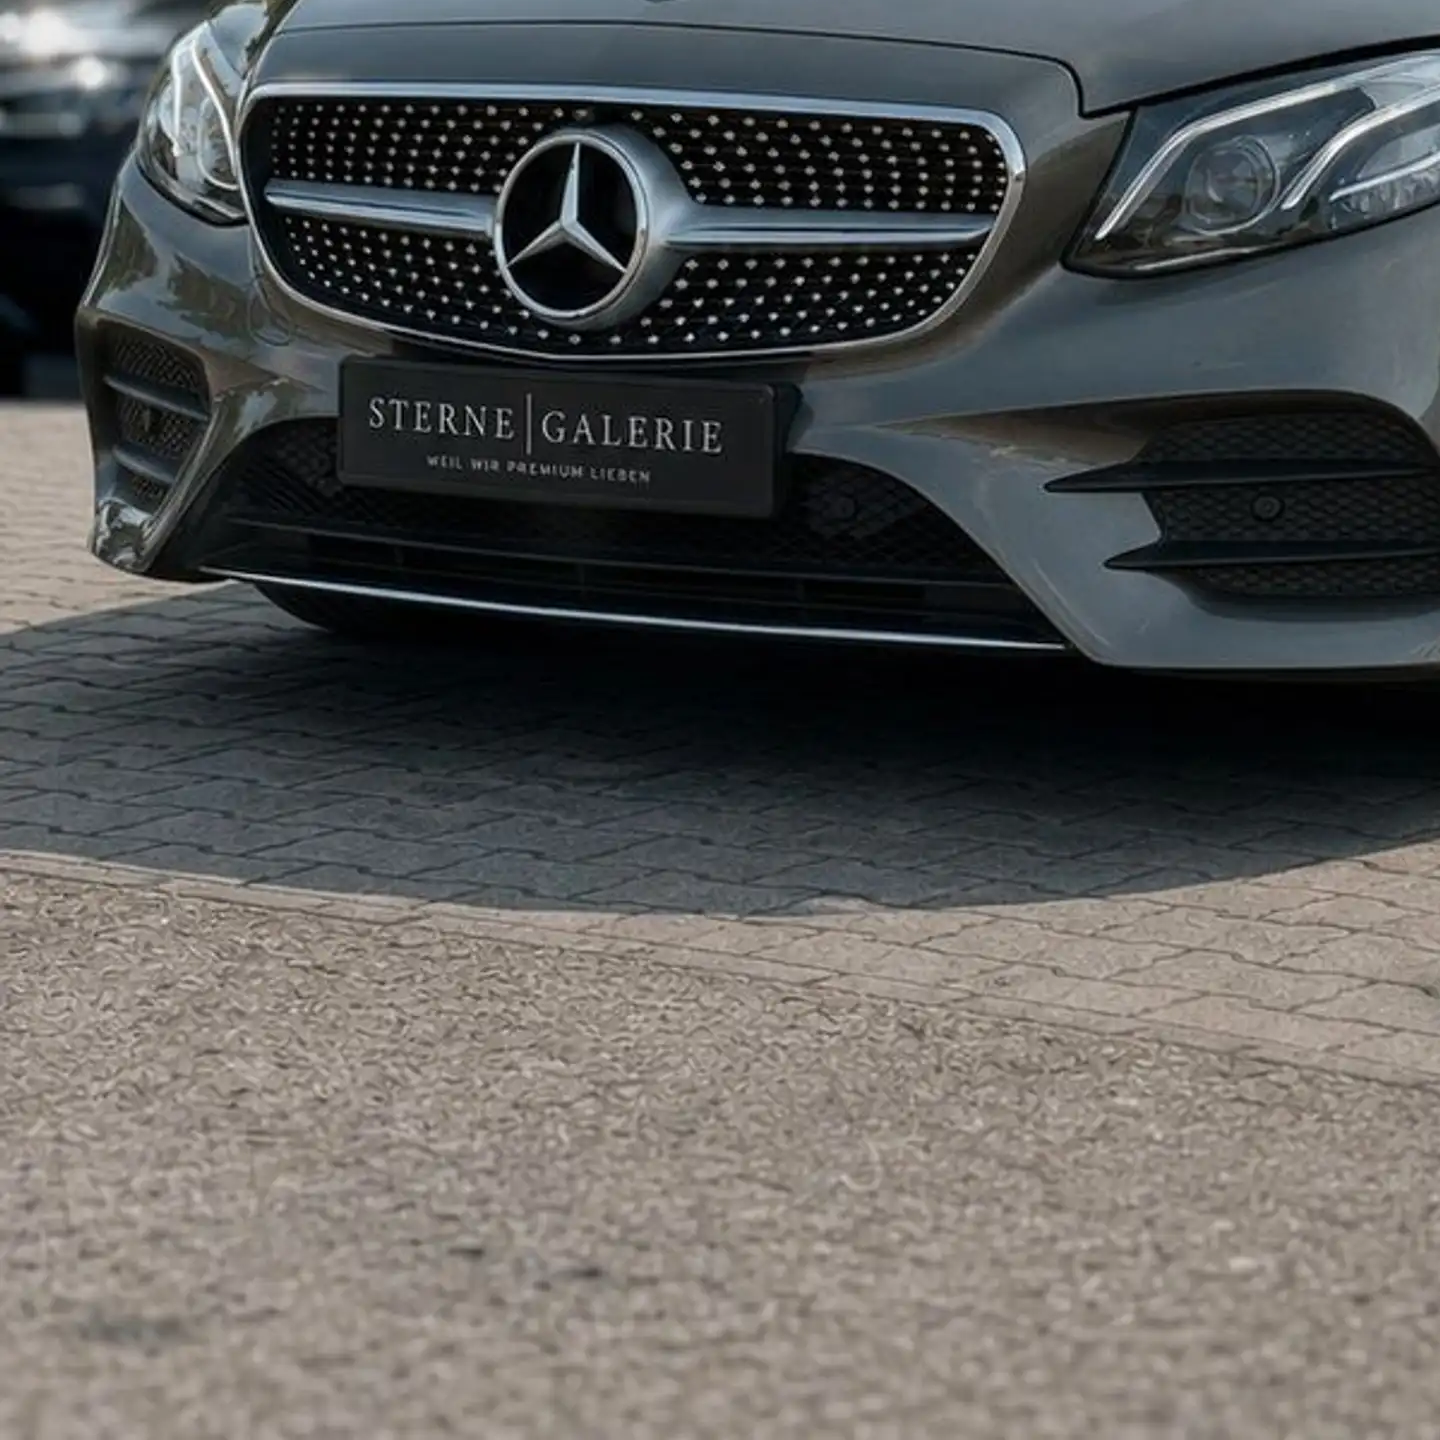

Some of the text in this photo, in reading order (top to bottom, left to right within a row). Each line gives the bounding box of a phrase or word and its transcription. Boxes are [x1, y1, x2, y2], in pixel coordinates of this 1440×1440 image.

[369, 396, 722, 454] STERNE GALERIE
[427, 455, 651, 483] WEIL WIR PREMIUM LIEBEN
